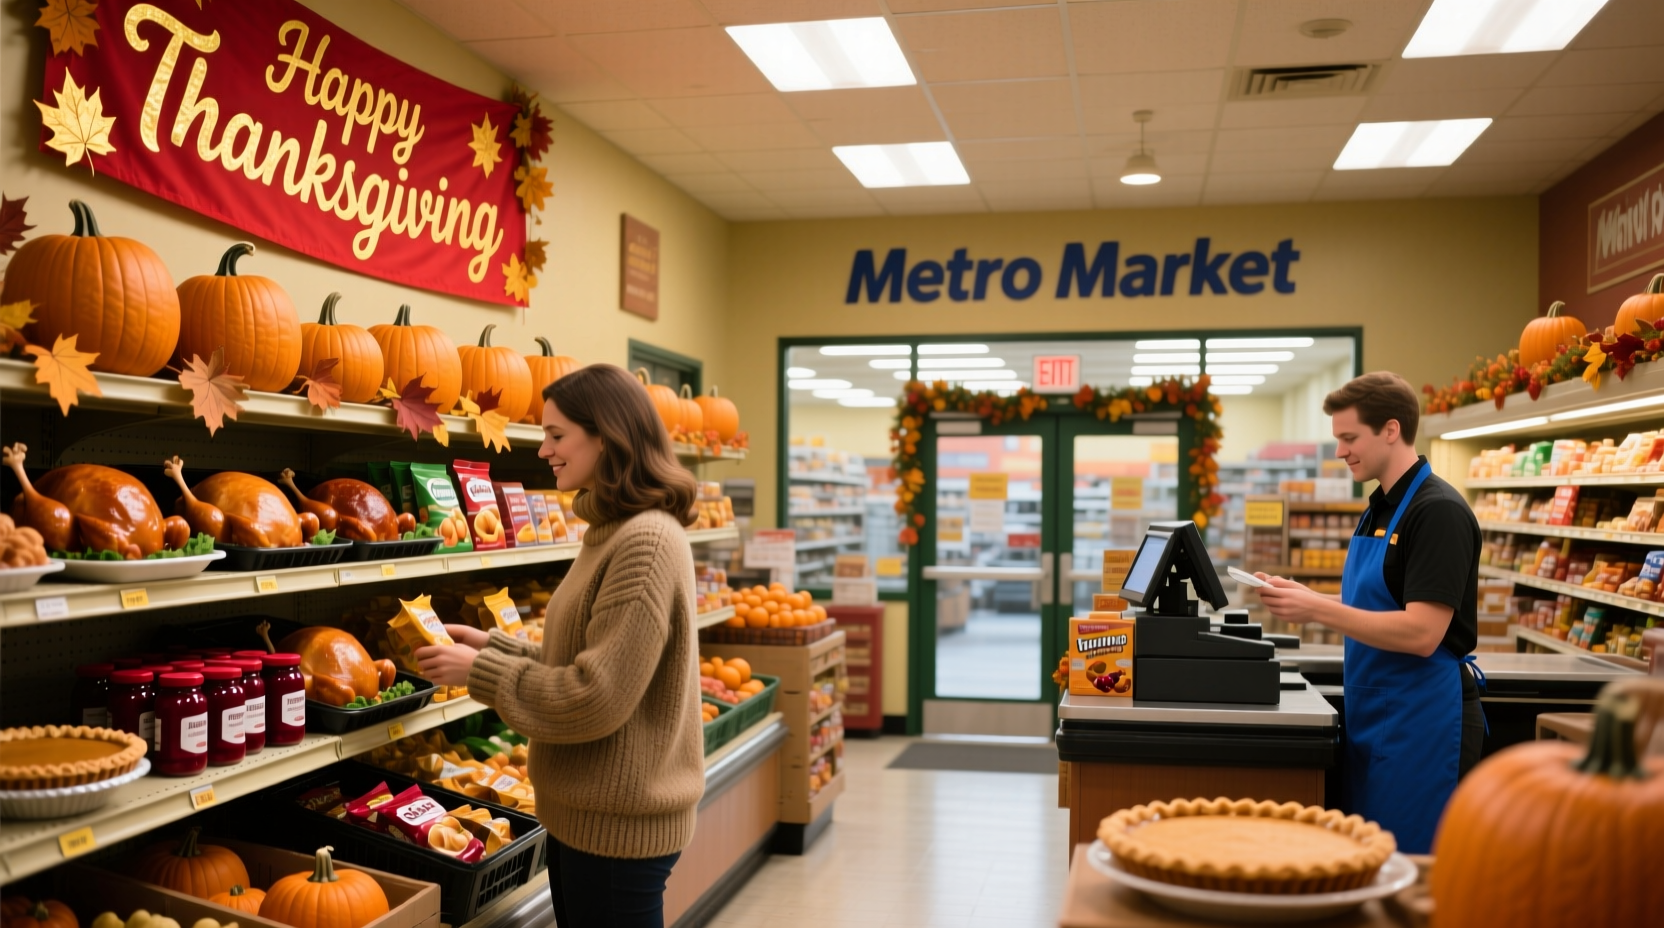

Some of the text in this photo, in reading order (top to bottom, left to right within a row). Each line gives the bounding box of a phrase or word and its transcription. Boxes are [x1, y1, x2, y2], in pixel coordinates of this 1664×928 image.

[123, 3, 504, 284] Thanksgiving
[265, 19, 426, 165] Happy
[846, 238, 1300, 303] Metro Market
